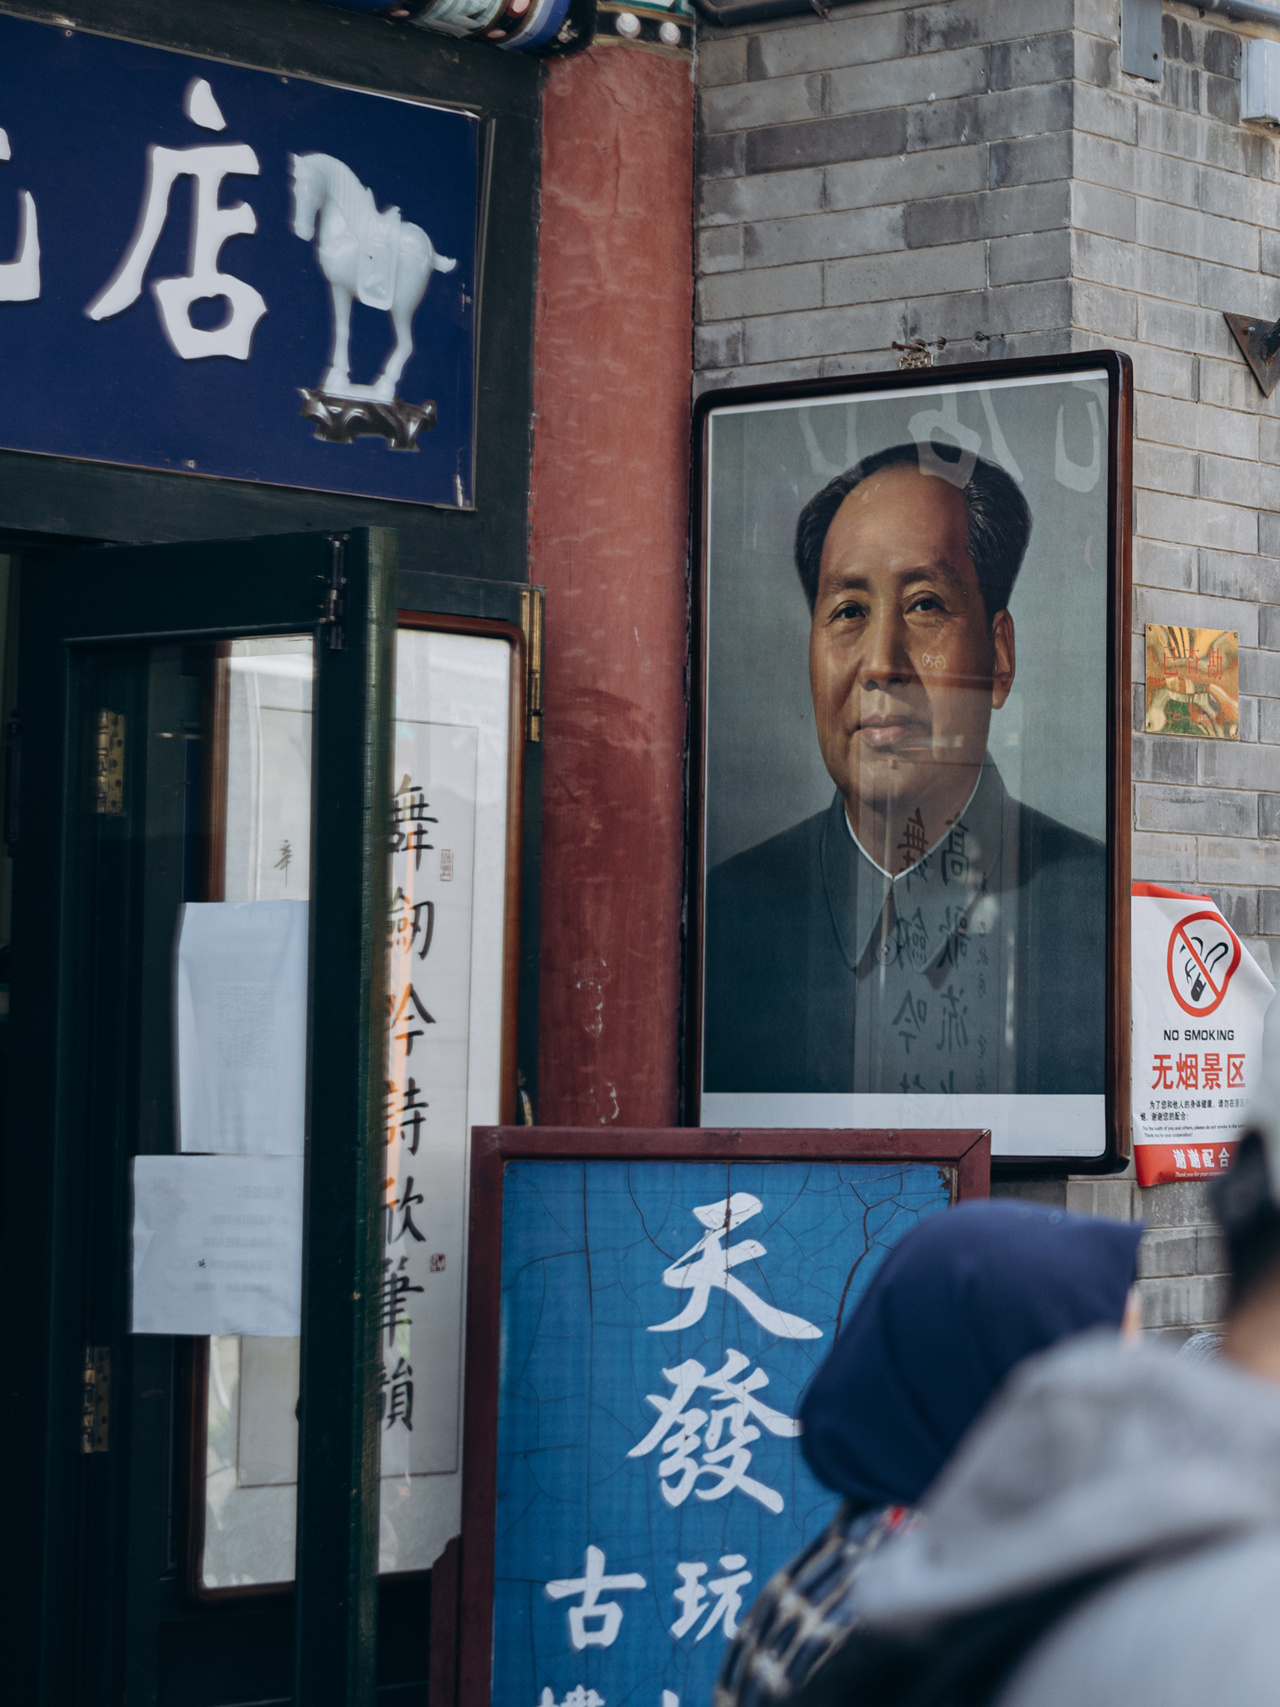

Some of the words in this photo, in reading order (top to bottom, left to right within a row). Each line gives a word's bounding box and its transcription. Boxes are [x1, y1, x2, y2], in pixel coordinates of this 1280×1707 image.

[1163, 1029, 1180, 1041] NO
[1184, 1029, 1235, 1041] SMOKING
[1151, 1052, 1246, 1091] 无烟景区
[1172, 1147, 1230, 1170] 谢谢配合
